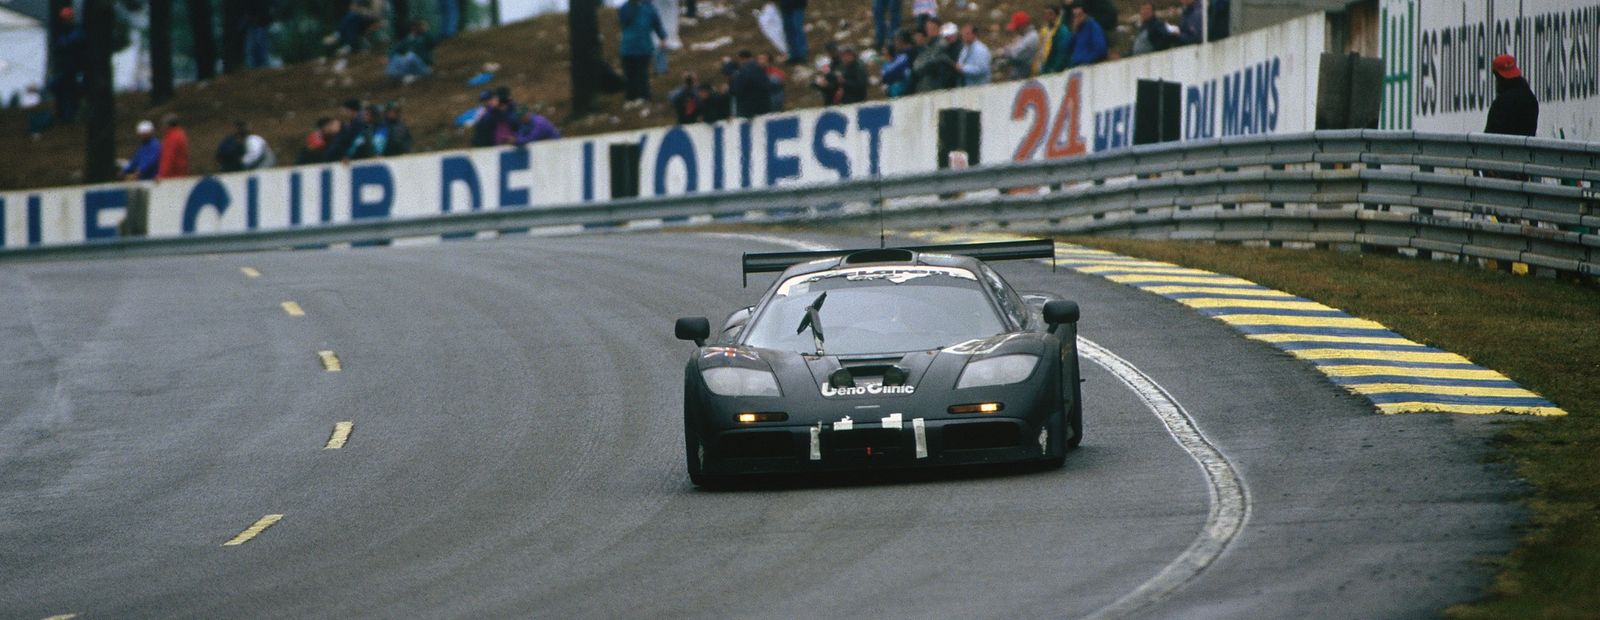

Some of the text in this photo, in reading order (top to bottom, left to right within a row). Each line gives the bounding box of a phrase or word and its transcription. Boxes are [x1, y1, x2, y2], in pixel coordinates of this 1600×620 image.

[1011, 72, 1086, 163] 24
[1186, 84, 1217, 140] DU
[1222, 55, 1281, 137] MANS
[1415, 0, 1438, 116] les
[1534, 10, 1567, 104] mans
[440, 147, 531, 215] DE
